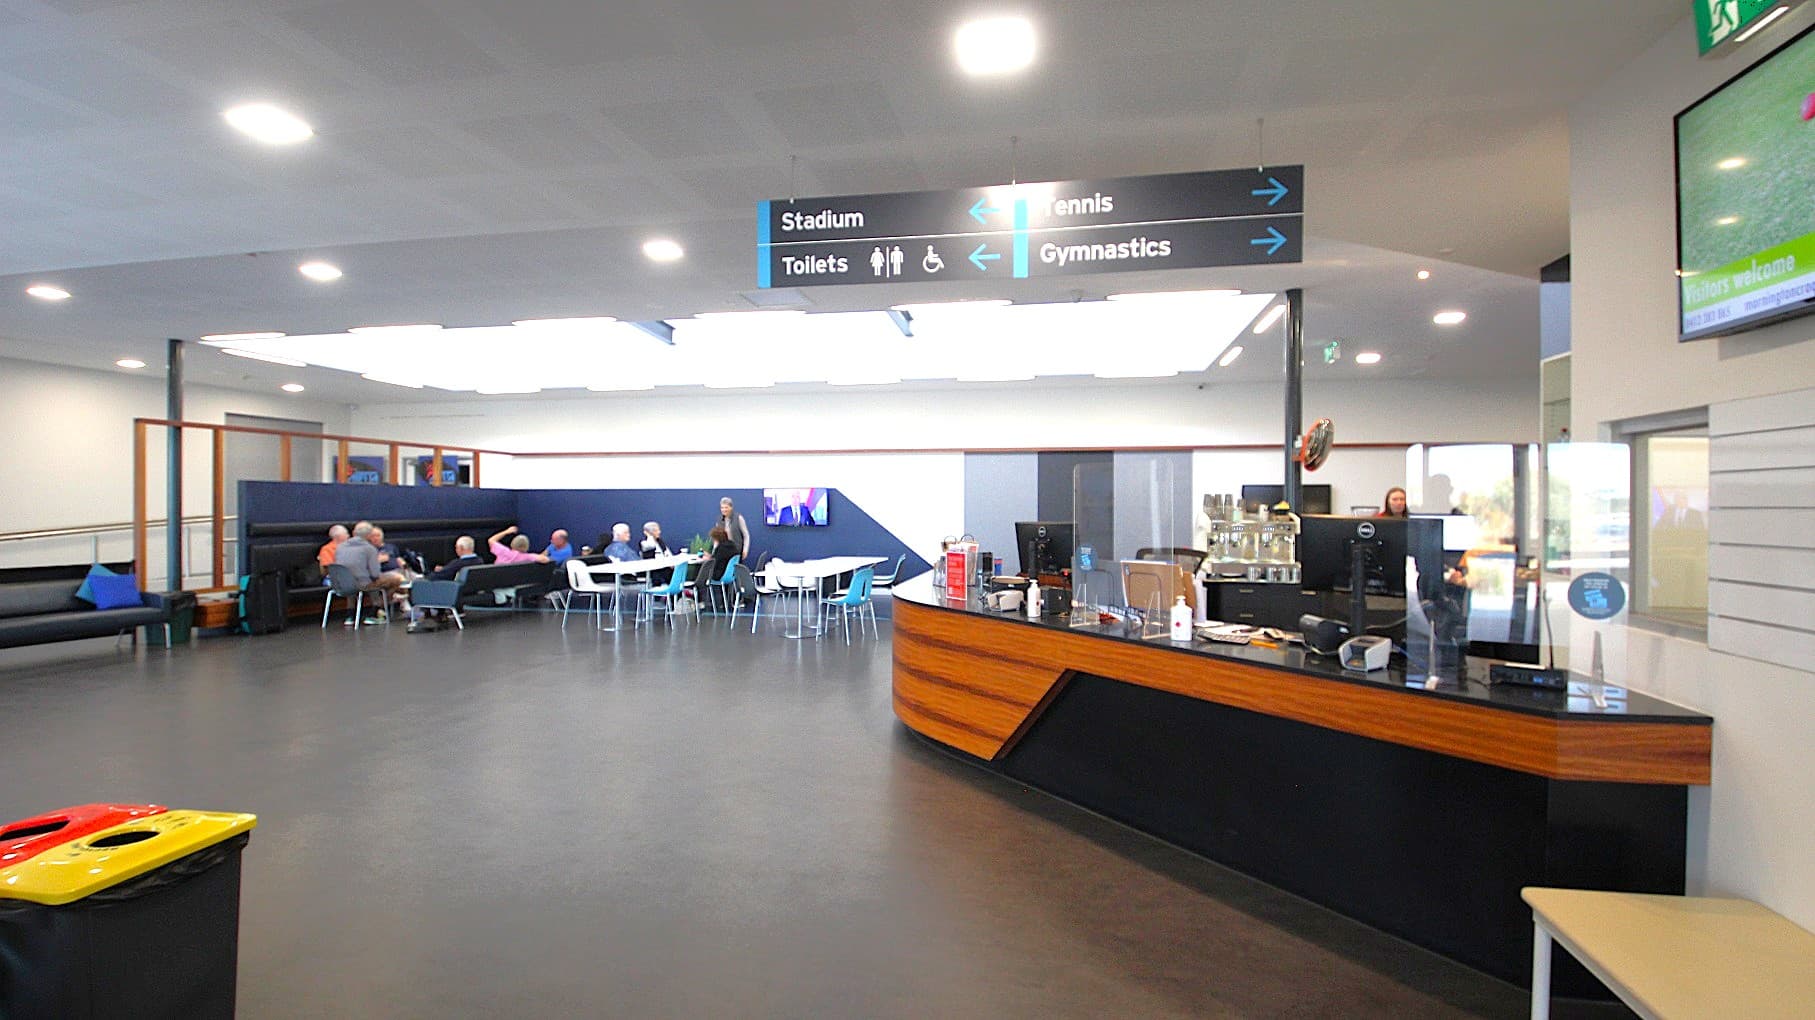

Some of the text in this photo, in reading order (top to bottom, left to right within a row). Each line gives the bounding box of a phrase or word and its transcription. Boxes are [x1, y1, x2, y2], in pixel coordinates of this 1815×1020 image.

[781, 209, 864, 231] Stadium
[781, 253, 849, 275] Toilets
[1039, 236, 1172, 266] Gymnastics
[1685, 254, 1796, 305] Visitors welcome
